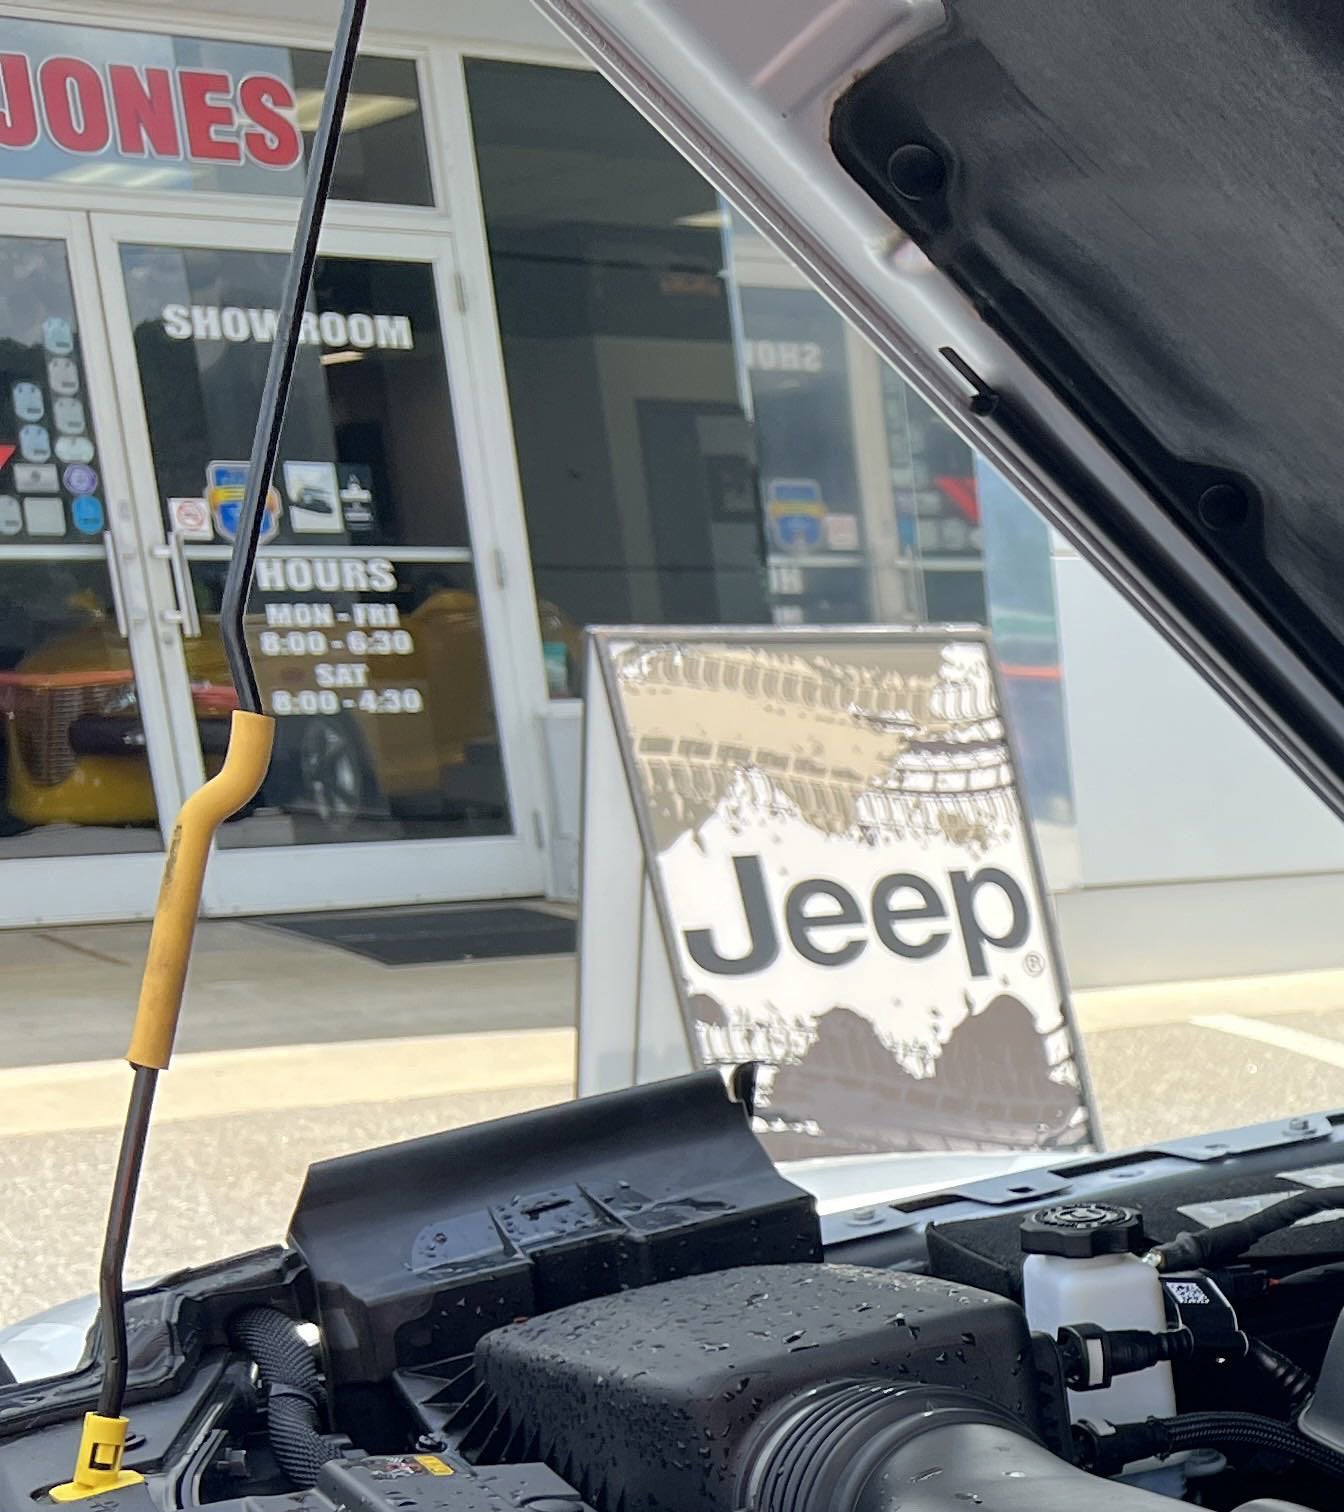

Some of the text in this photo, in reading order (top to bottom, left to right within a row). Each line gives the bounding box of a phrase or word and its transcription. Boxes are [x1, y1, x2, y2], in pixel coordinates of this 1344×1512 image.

[0, 50, 303, 170] JONES
[256, 557, 397, 592] HOURS
[314, 663, 370, 688] SAT
[682, 854, 1031, 978] Jeep
